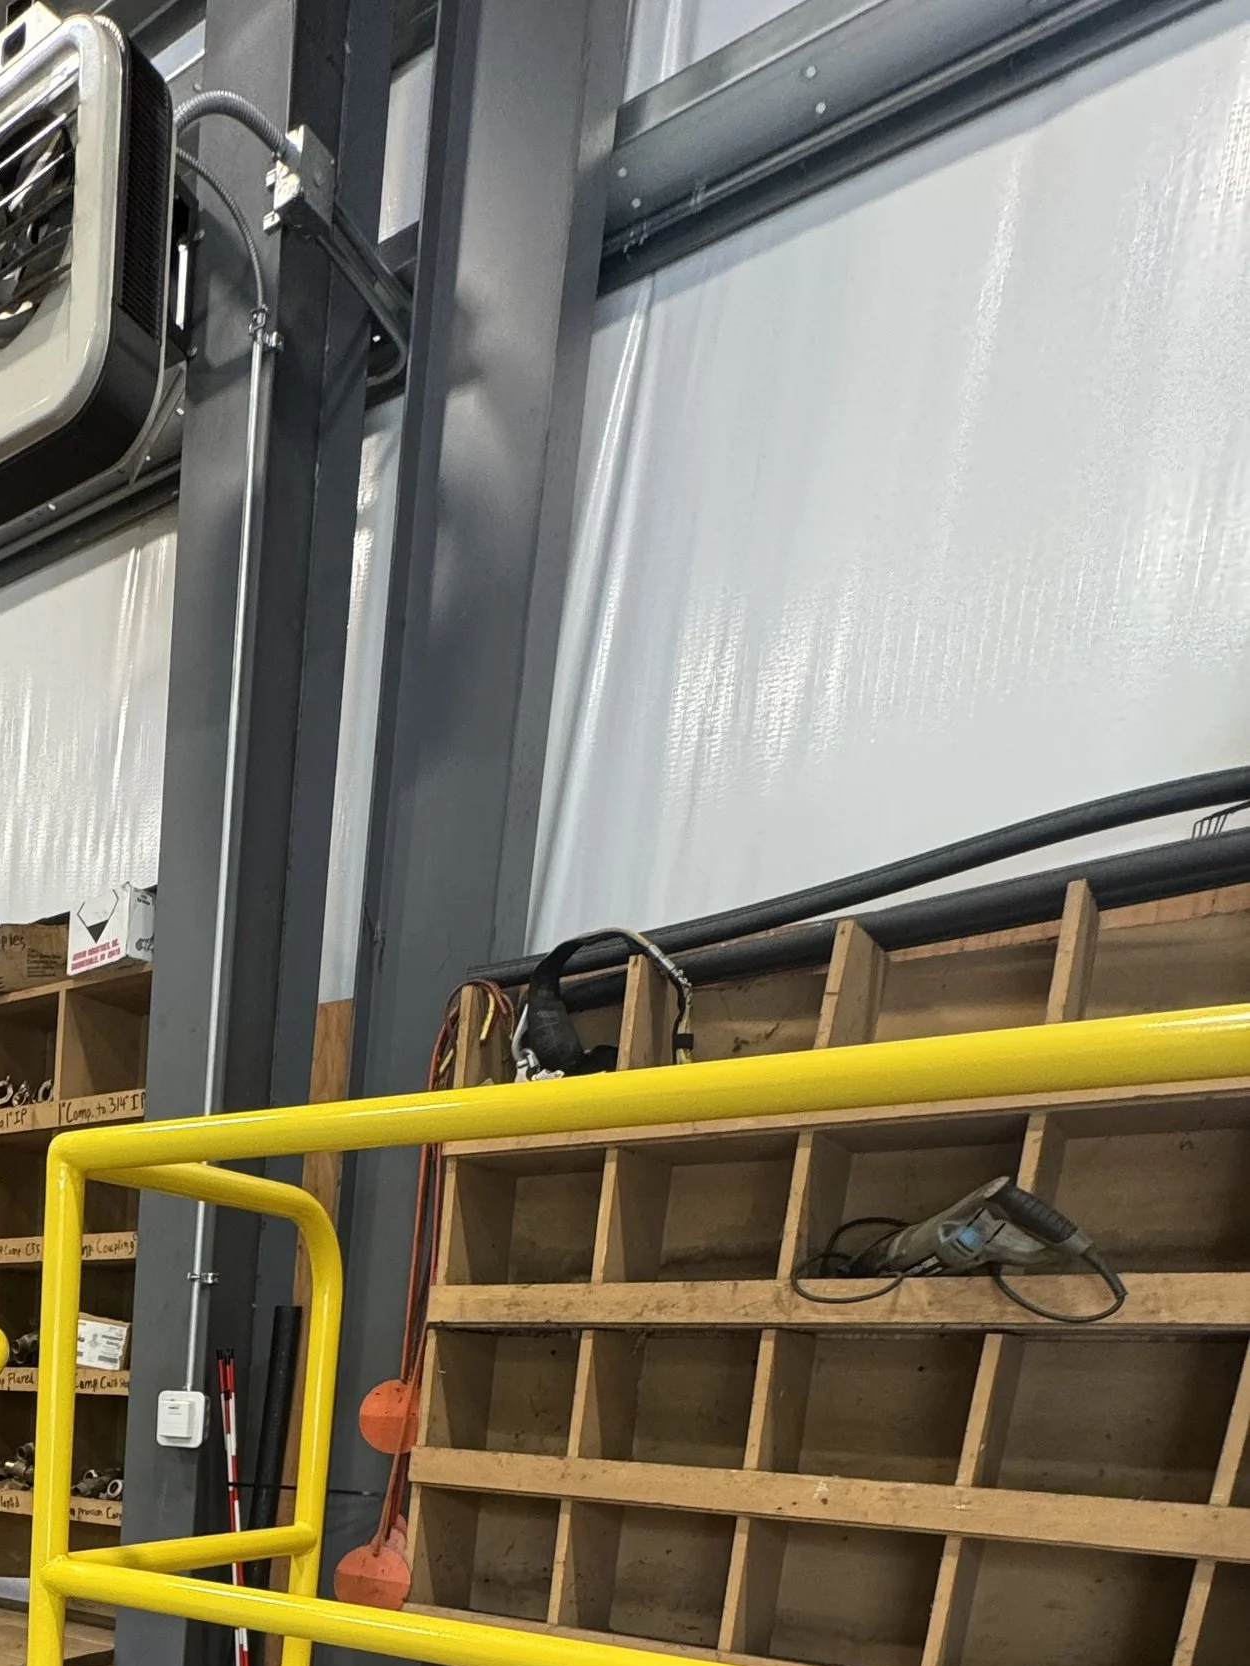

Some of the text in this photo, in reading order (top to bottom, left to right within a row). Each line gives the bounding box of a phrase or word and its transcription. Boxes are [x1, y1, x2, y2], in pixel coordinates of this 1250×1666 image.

[13, 1107, 27, 1126] IP
[96, 1102, 106, 1116] to
[95, 1237, 135, 1256] Coupling
